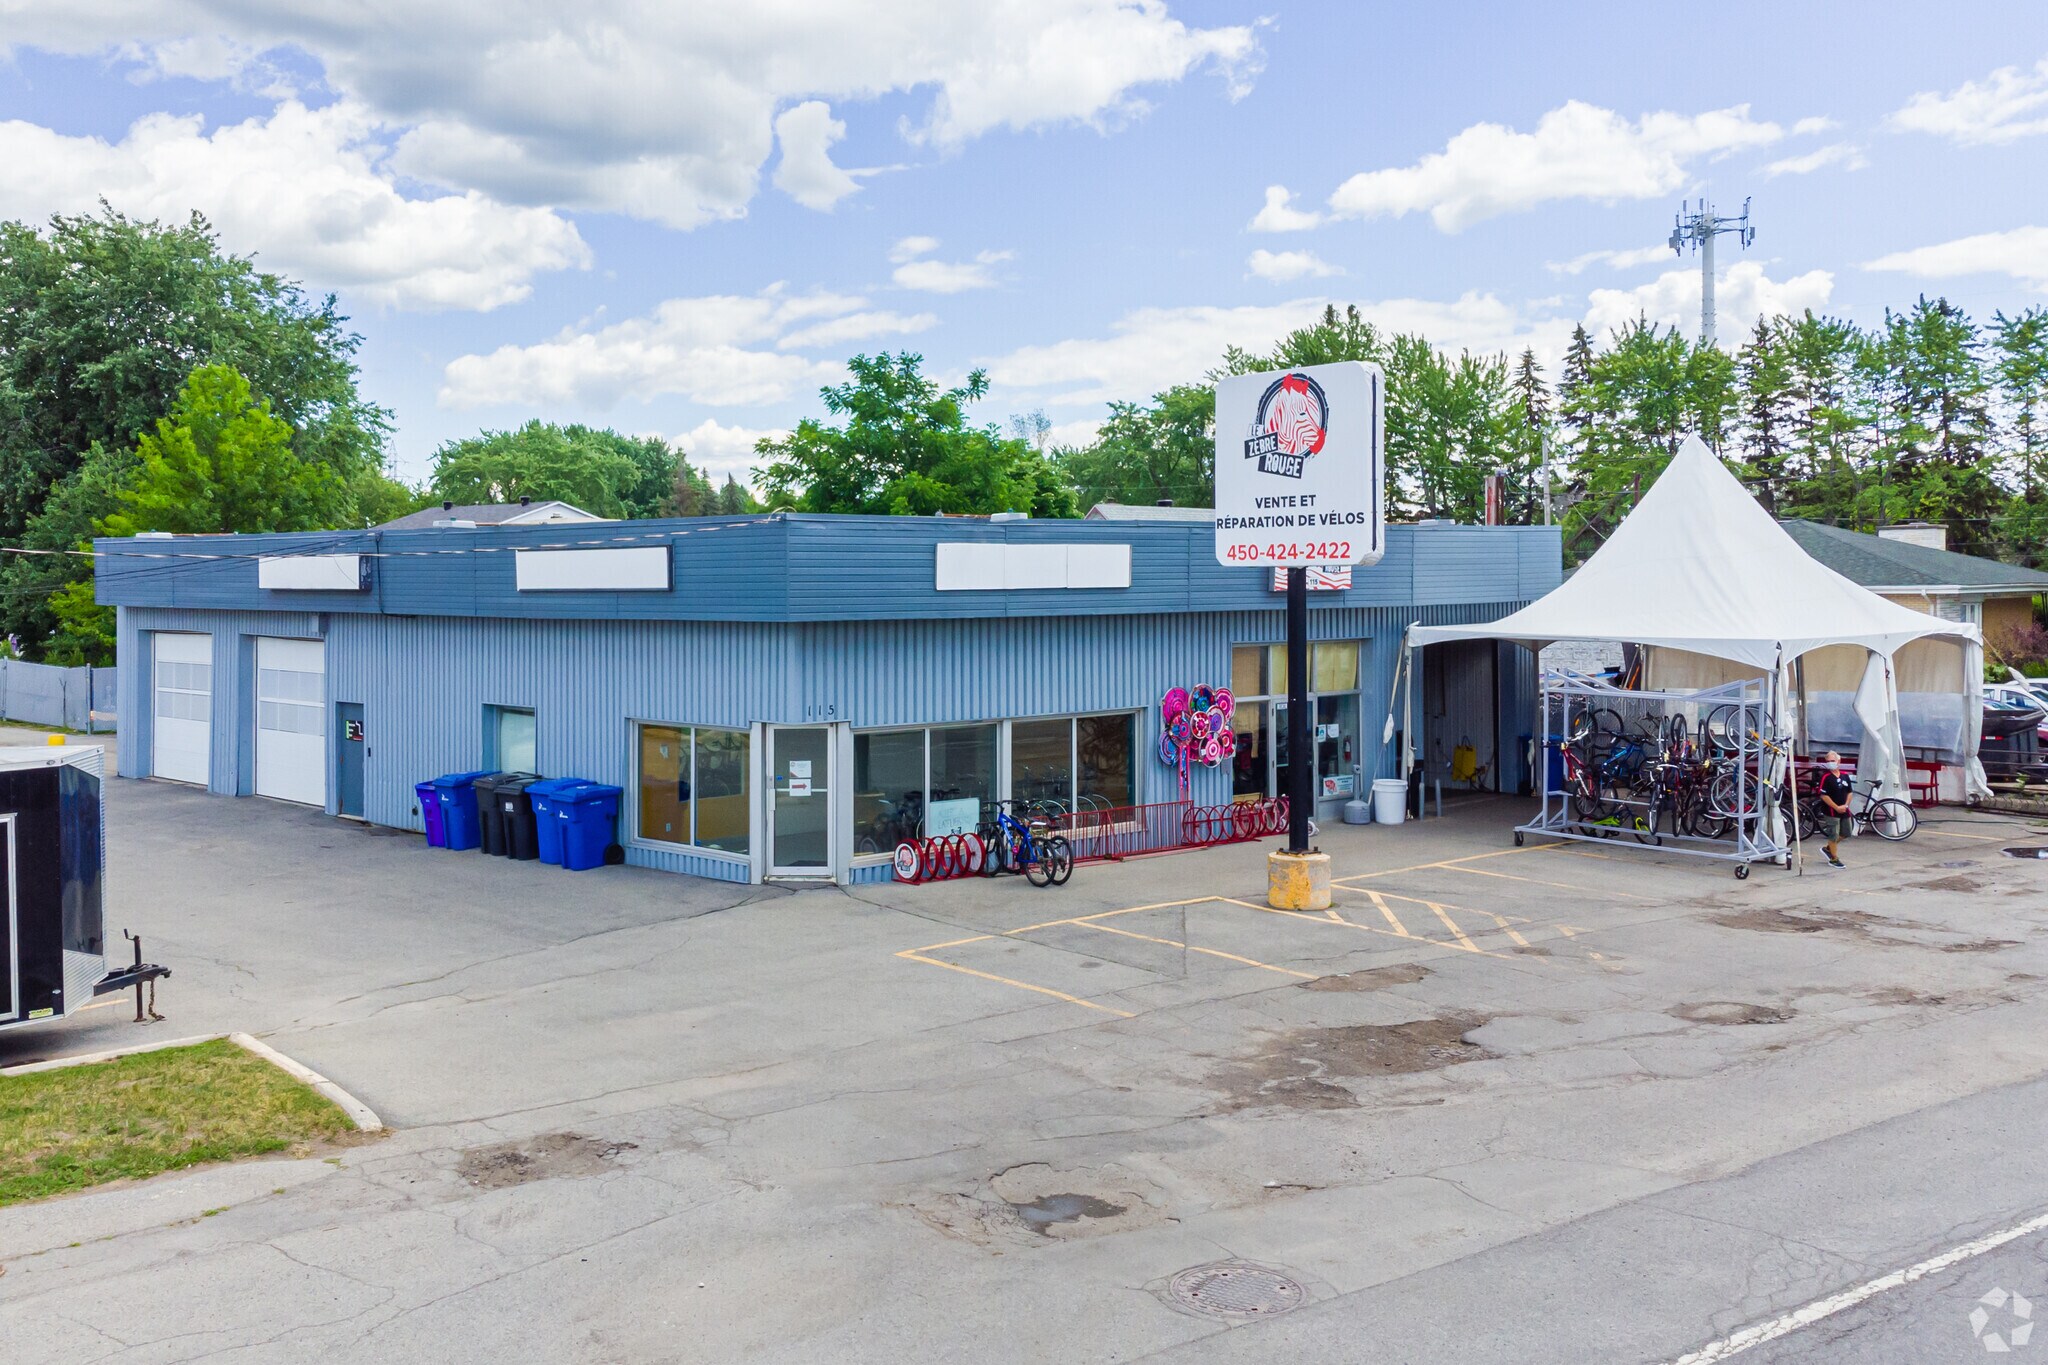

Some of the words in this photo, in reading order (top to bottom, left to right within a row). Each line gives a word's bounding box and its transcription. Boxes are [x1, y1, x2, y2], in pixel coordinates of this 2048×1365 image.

[1265, 453, 1302, 477] ROUGE
[1255, 496, 1296, 508] VENTE
[1300, 494, 1316, 506] ET
[1216, 514, 1294, 529] RÉPARATION
[1299, 514, 1316, 527] DE
[1319, 510, 1365, 526] VÉLOS
[1227, 542, 1350, 561] 450-424-2422
[808, 704, 834, 717] 115
